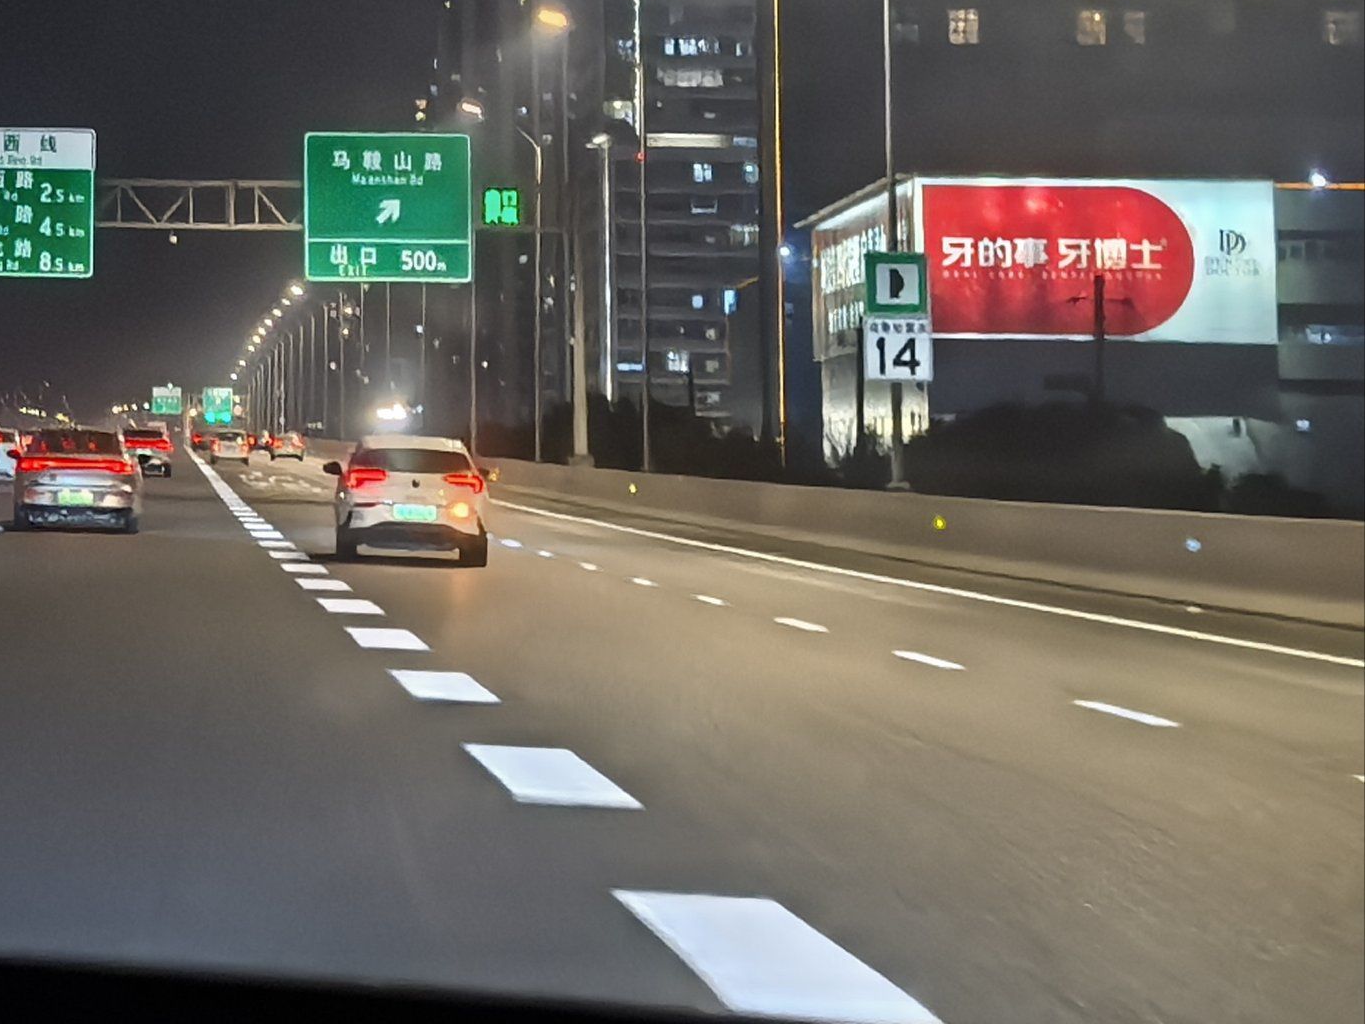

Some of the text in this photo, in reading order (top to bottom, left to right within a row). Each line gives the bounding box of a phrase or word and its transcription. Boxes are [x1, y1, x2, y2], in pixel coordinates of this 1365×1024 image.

[332, 149, 442, 171] 马鞍山路
[330, 244, 376, 265] 出口
[941, 236, 1163, 270] 牙的事 牙博士
[876, 336, 921, 376] 14
